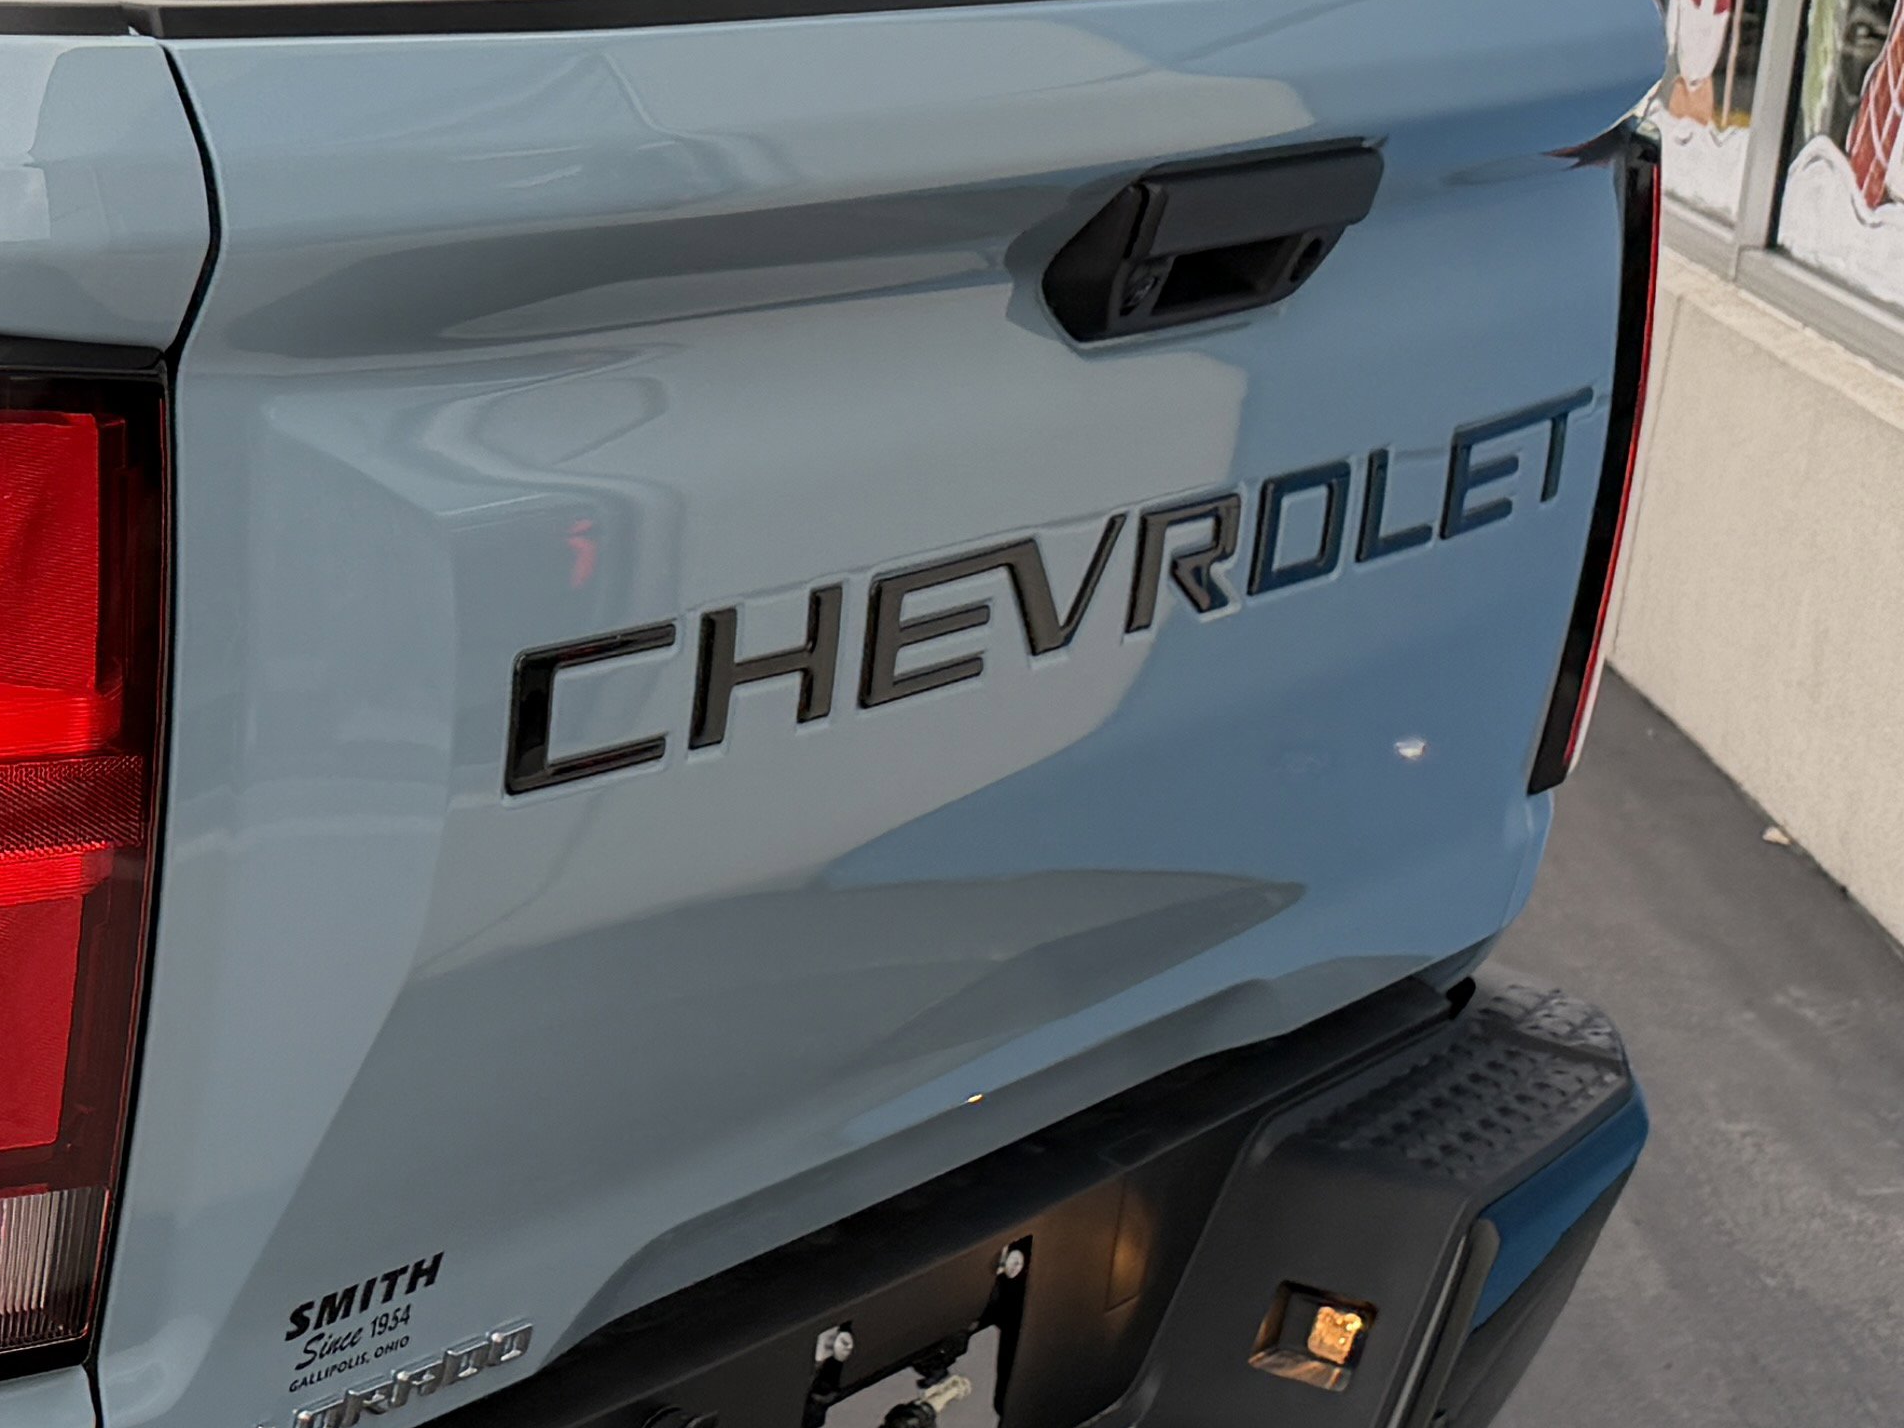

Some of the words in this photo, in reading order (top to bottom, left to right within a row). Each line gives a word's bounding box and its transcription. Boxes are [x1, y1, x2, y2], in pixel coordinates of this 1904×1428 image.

[503, 385, 1595, 798] CHEVROLET
[284, 1251, 444, 1342] SMITH
[288, 1349, 371, 1393] GALLIPOLIS,
[373, 1335, 410, 1360] OHIO
[295, 1326, 363, 1372] Since
[370, 1304, 412, 1339] 1954
